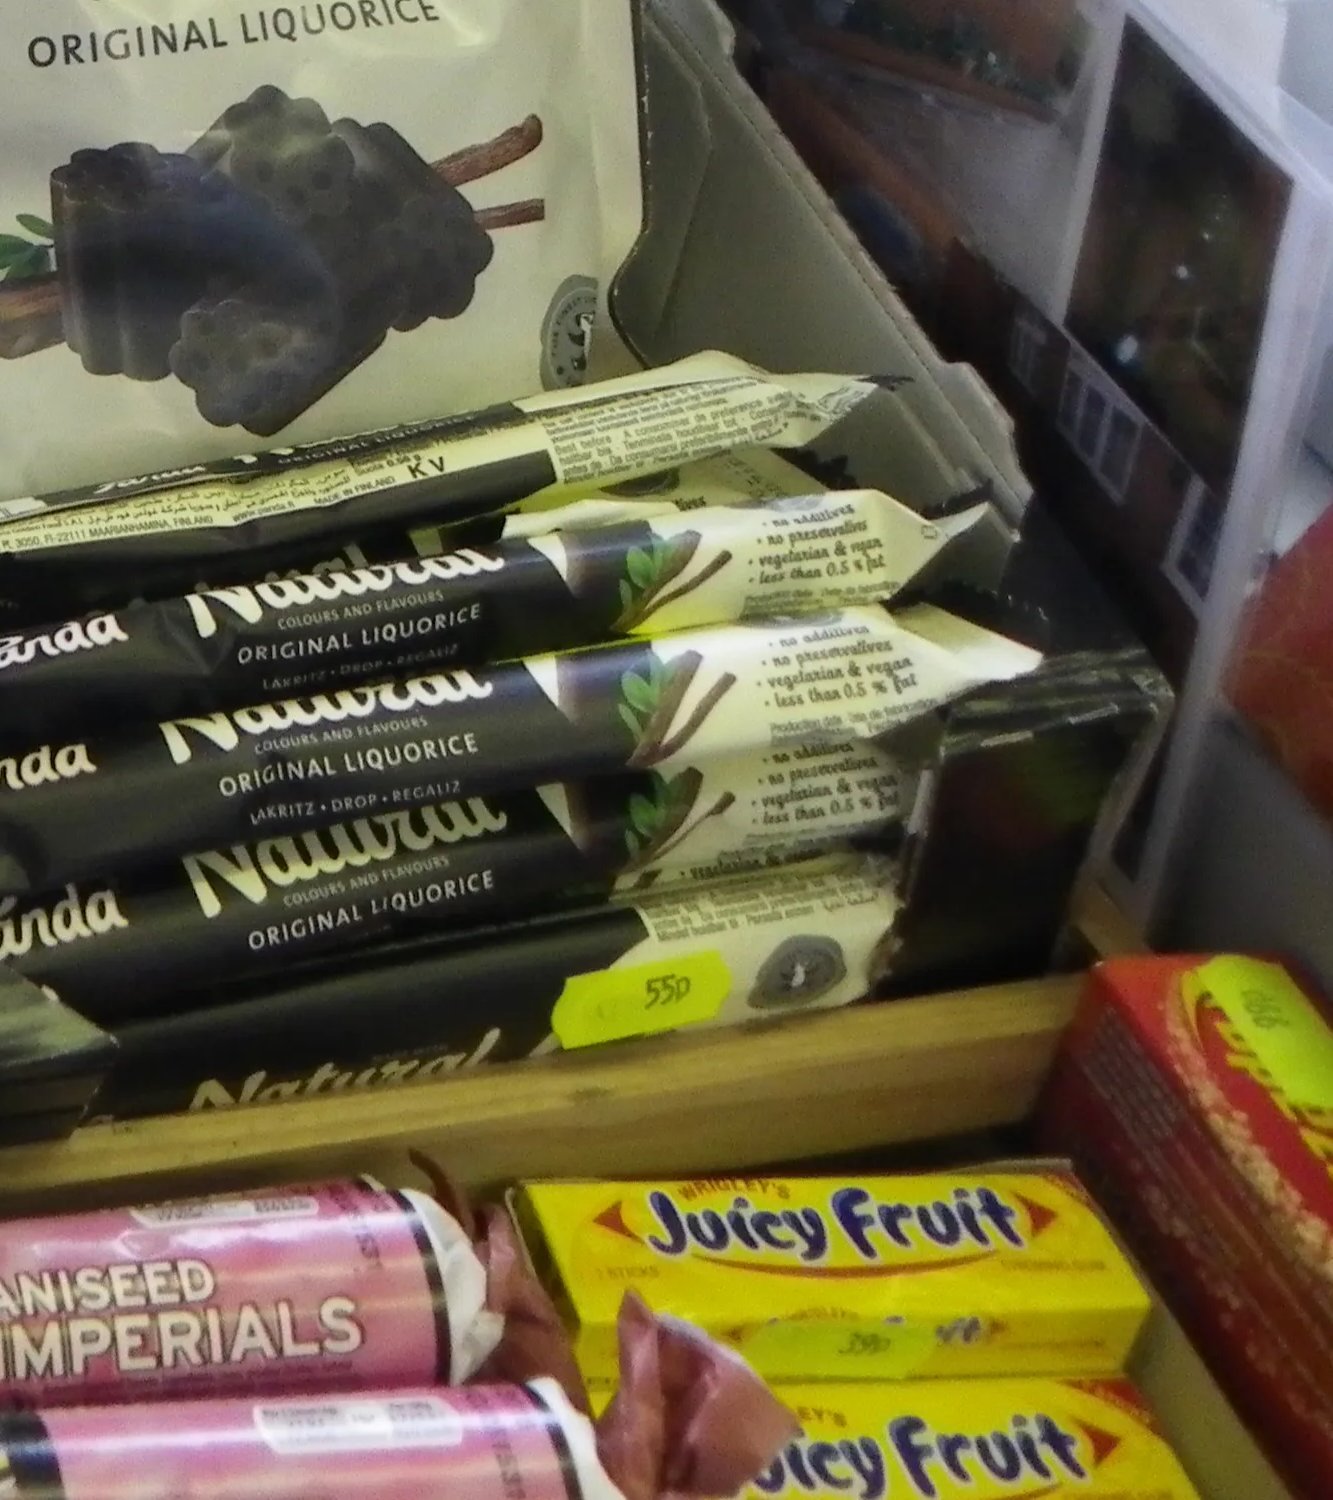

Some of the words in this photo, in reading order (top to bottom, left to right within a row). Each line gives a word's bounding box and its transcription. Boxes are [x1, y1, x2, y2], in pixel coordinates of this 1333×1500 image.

[26, 14, 232, 71] ORIGINAL
[183, 547, 506, 640] Natural
[277, 611, 340, 632] COLOURS
[342, 603, 373, 620] AND
[375, 588, 446, 614] FLAVOURS
[237, 632, 354, 666] ORIGINAL
[360, 603, 483, 646] LIQUORICE
[158, 668, 495, 767] Natural
[253, 733, 319, 756] COLOURS
[322, 726, 354, 743] AND
[356, 714, 429, 740] FLAVOURS
[218, 754, 338, 799] ORIGINAL
[342, 731, 480, 774] LIQUORICE
[181, 795, 509, 920] Natural
[282, 880, 347, 909] COLOURS
[349, 870, 380, 891] AND
[381, 854, 451, 881] FLAVOURS
[246, 904, 364, 953] ORIGINAL
[370, 868, 496, 916] LIQUORICE
[647, 1190, 829, 1264] Juicy
[829, 1185, 1027, 1261] Fruit
[887, 1412, 1091, 1500] Fruit
